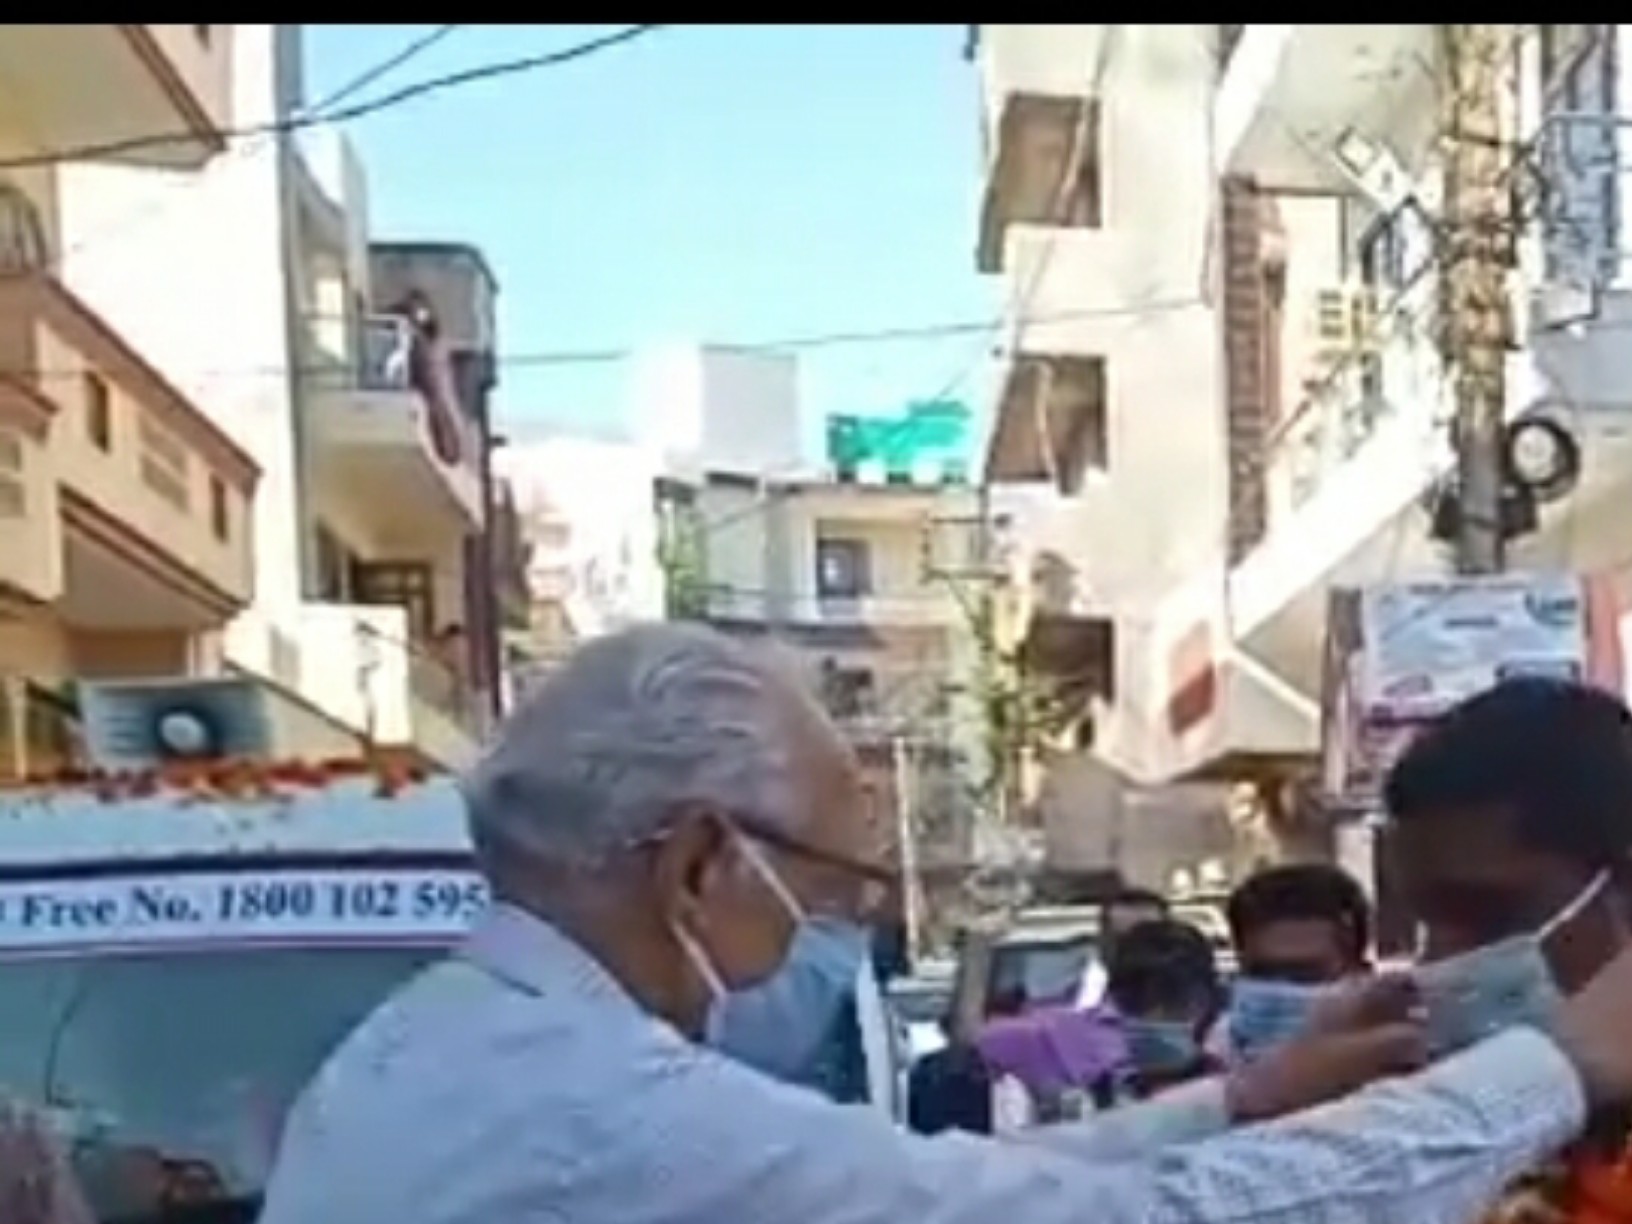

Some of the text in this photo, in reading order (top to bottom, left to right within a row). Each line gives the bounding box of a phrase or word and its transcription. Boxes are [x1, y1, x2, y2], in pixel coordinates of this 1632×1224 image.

[22, 894, 118, 928] Free
[125, 886, 202, 927] No.
[219, 880, 316, 921] 1800
[328, 879, 399, 919] 102
[413, 879, 486, 921] 595
